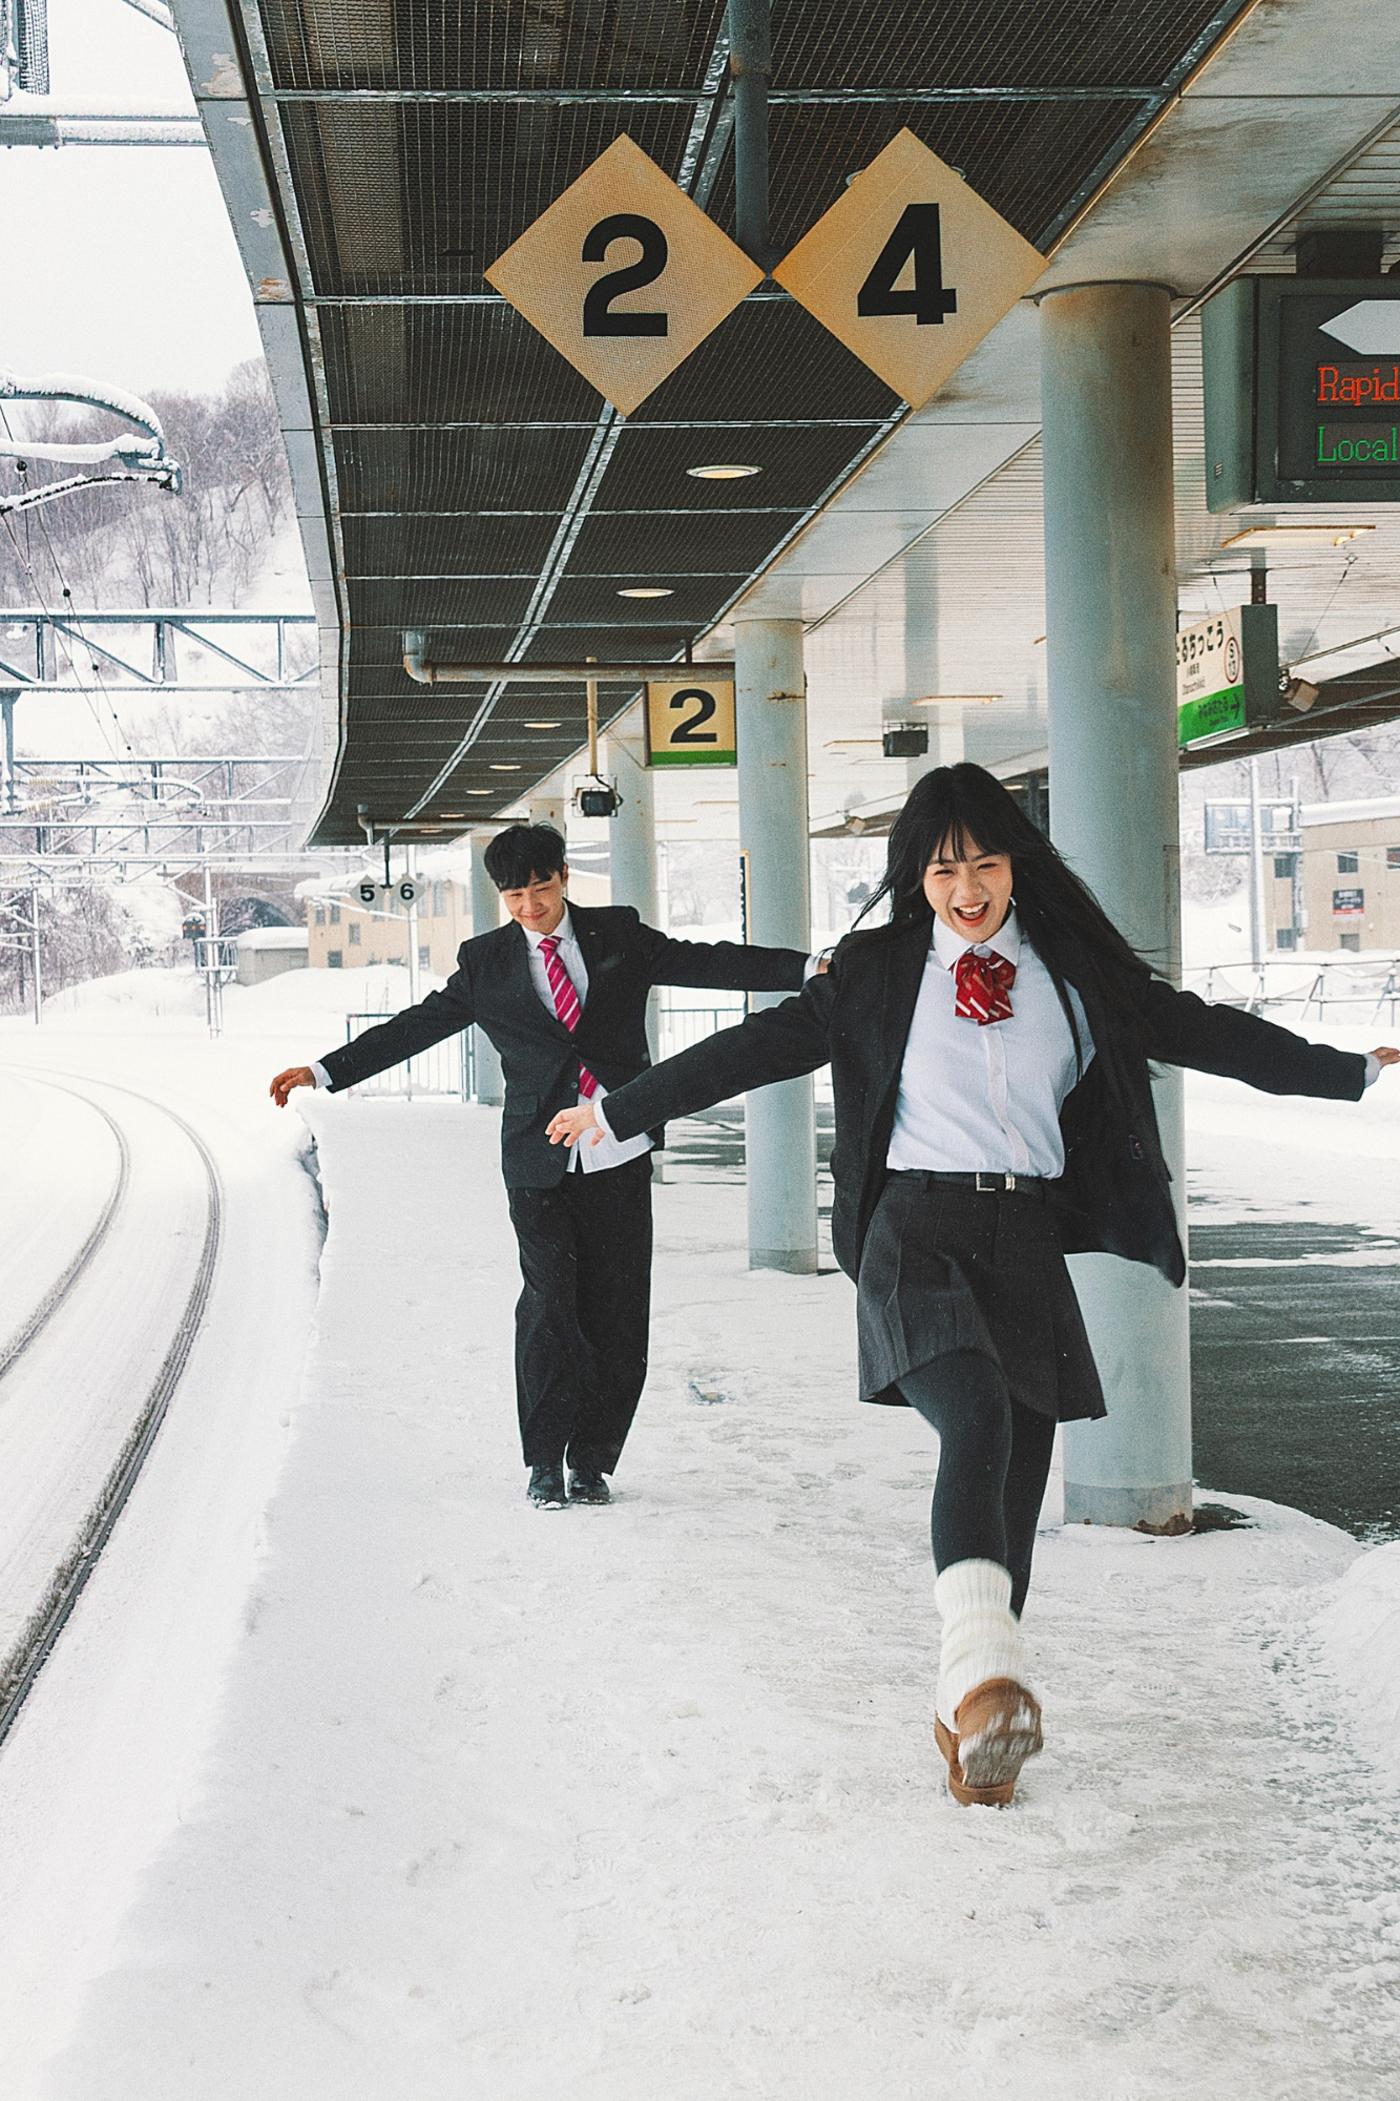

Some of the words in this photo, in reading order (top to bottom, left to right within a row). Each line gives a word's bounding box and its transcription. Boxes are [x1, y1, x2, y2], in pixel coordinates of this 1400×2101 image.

[581, 213, 668, 337] 2
[857, 202, 957, 325] 4
[1317, 366, 1400, 406] Rapid
[1317, 426, 1397, 461] Local
[669, 688, 717, 743] 2
[360, 884, 375, 902] 5
[400, 883, 414, 900] 6
